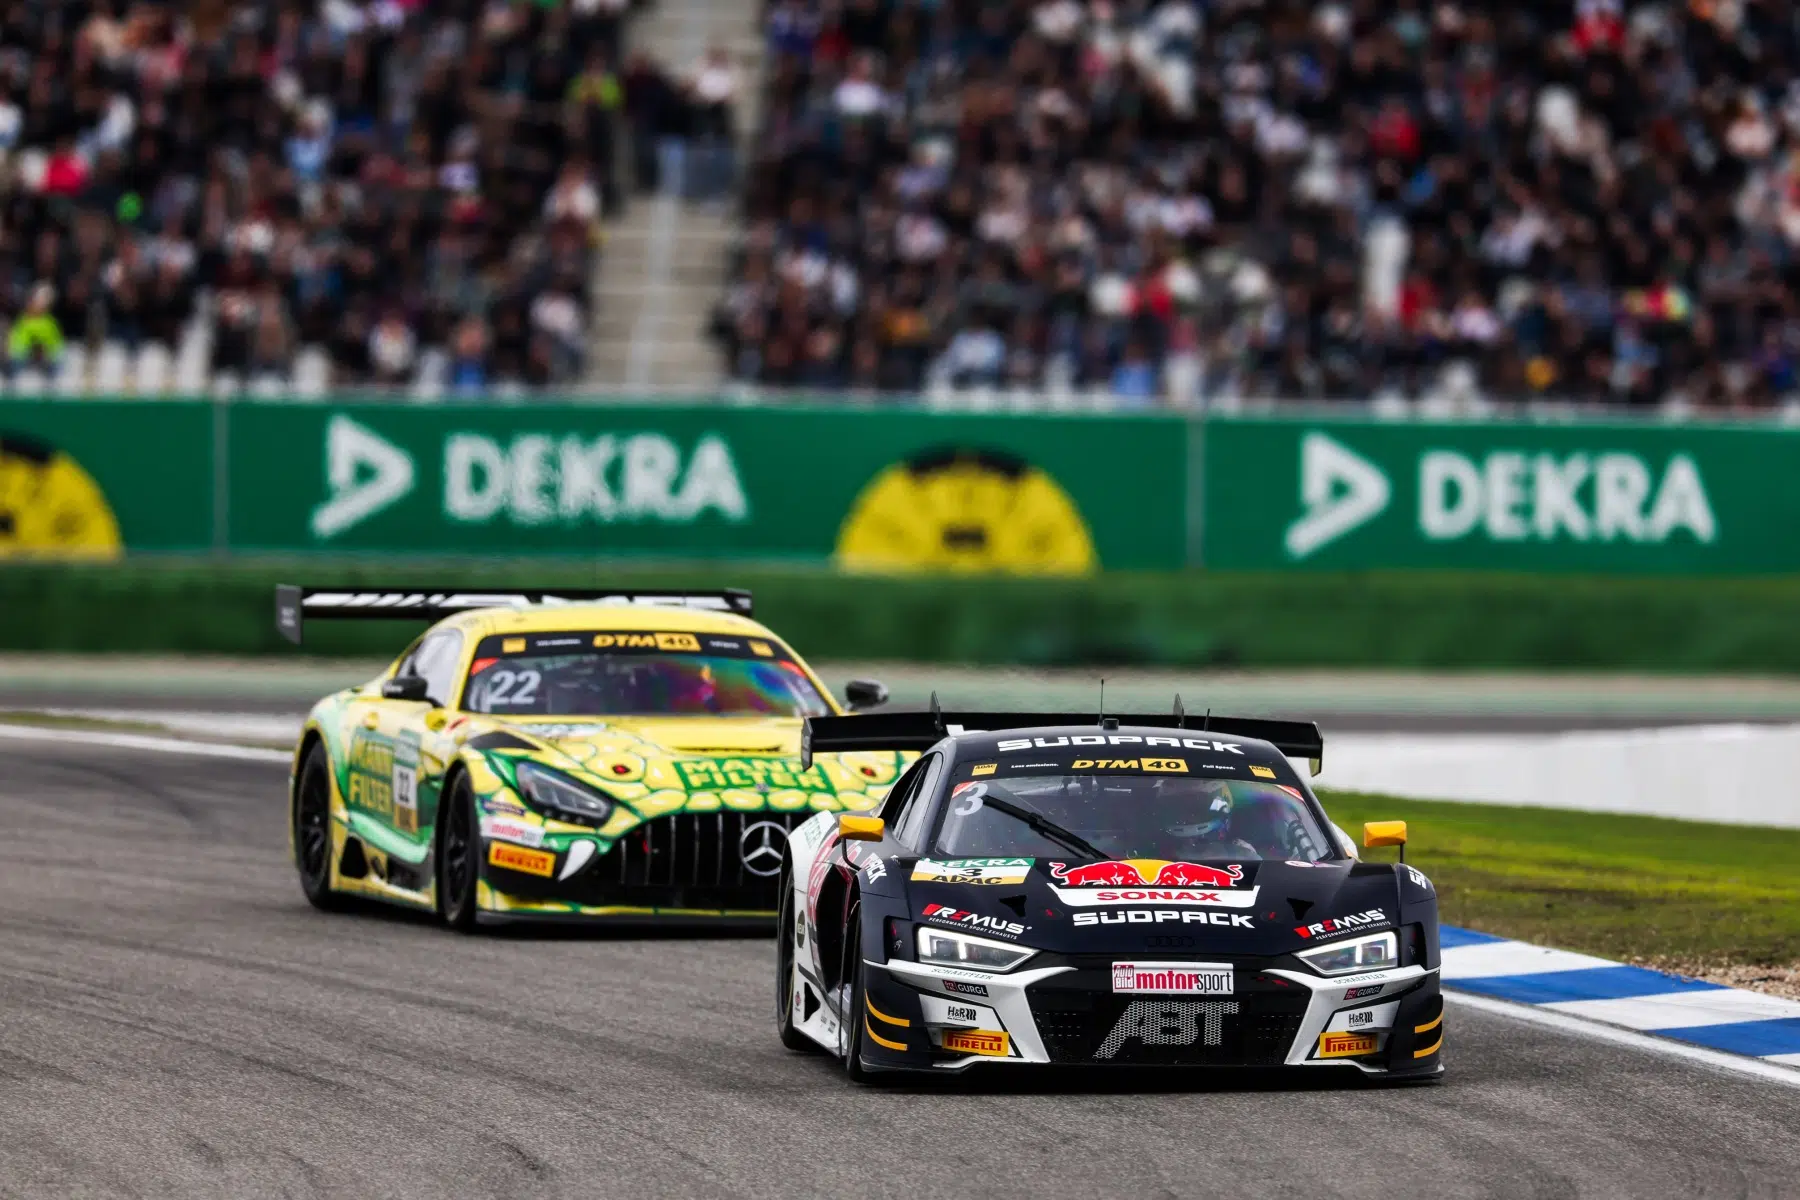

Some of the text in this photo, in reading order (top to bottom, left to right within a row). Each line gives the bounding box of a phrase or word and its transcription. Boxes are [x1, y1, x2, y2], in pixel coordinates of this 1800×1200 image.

[444, 433, 748, 524] DEKRA
[1419, 452, 1716, 543] DEKRA
[592, 634, 656, 647] DTM
[663, 635, 692, 646] 40
[488, 669, 541, 705] 22
[1071, 759, 1182, 770] DTM 40
[954, 782, 988, 816] 3
[931, 875, 1004, 885] ADAC
[960, 868, 983, 877] 3
[1096, 891, 1221, 902] SONAX
[928, 916, 1018, 940] PERFORMANCE SPORT EXHAUSTS
[933, 906, 1025, 935] REMUS
[1307, 907, 1386, 935] REMUS
[1315, 929, 1351, 940] PERFORMANCE
[930, 967, 994, 980] SCHAEFFLER
[957, 984, 988, 995] GURGL
[1092, 1000, 1240, 1059] ABT
[946, 1031, 1003, 1052] PIRELLI
[1325, 1036, 1373, 1053] PIRELLI
